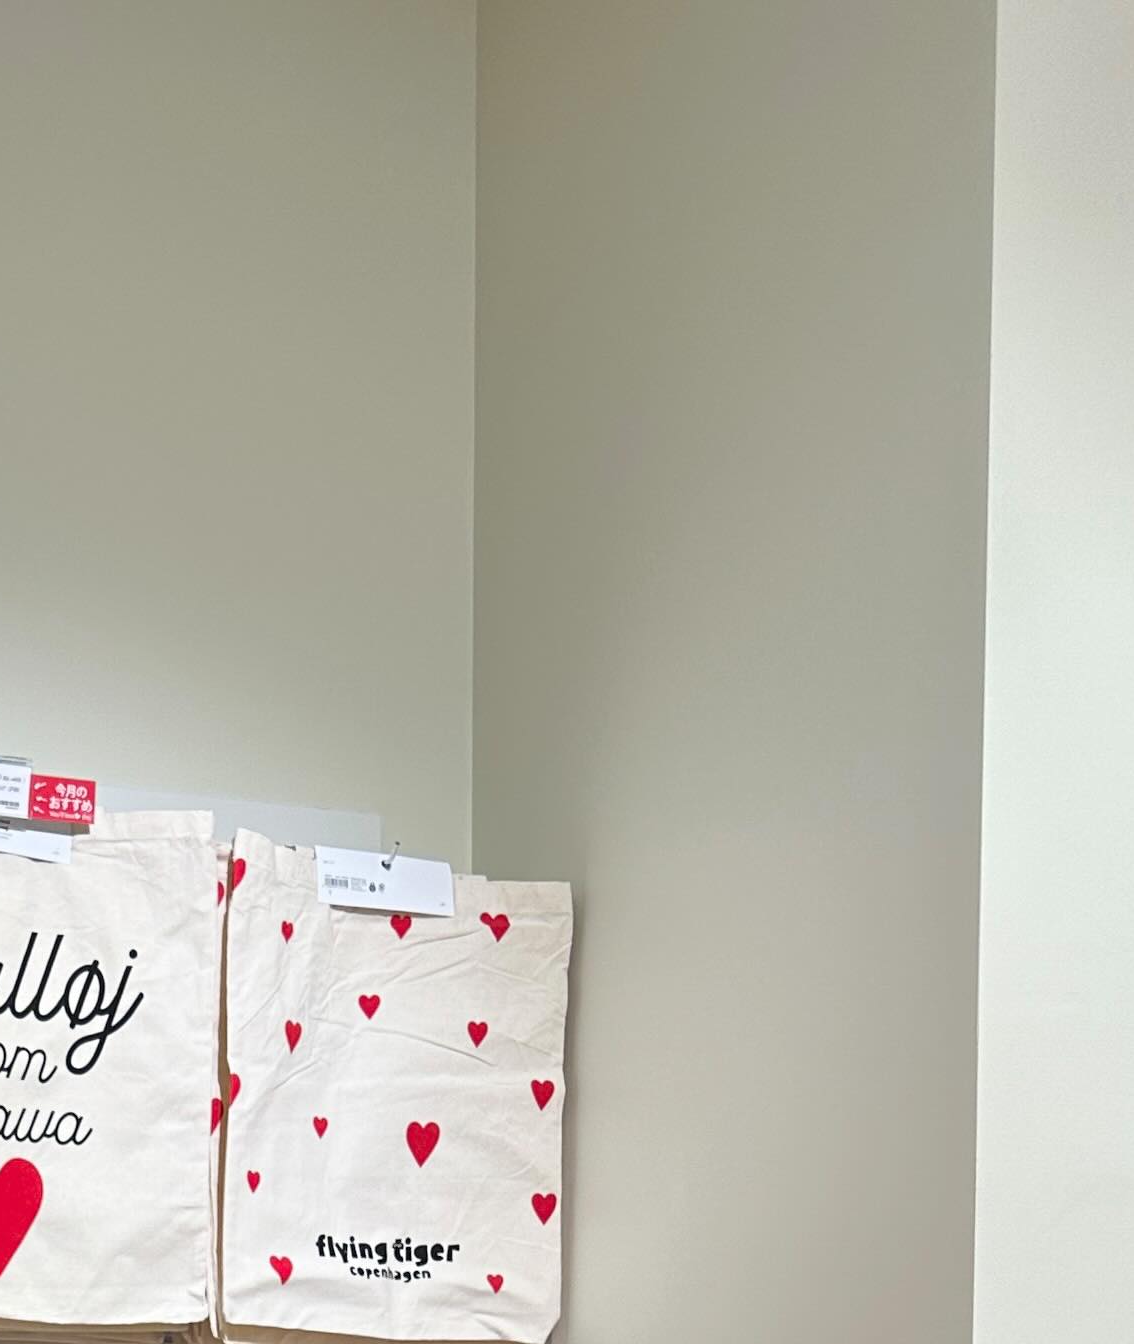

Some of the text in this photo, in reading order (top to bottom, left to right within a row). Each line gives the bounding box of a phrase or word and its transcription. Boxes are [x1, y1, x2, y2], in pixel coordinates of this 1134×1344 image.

[55, 783, 88, 798] 今月の
[49, 797, 93, 813] おすすめ
[316, 1234, 460, 1267] flying tiger
[350, 1265, 432, 1283] copenhagen
